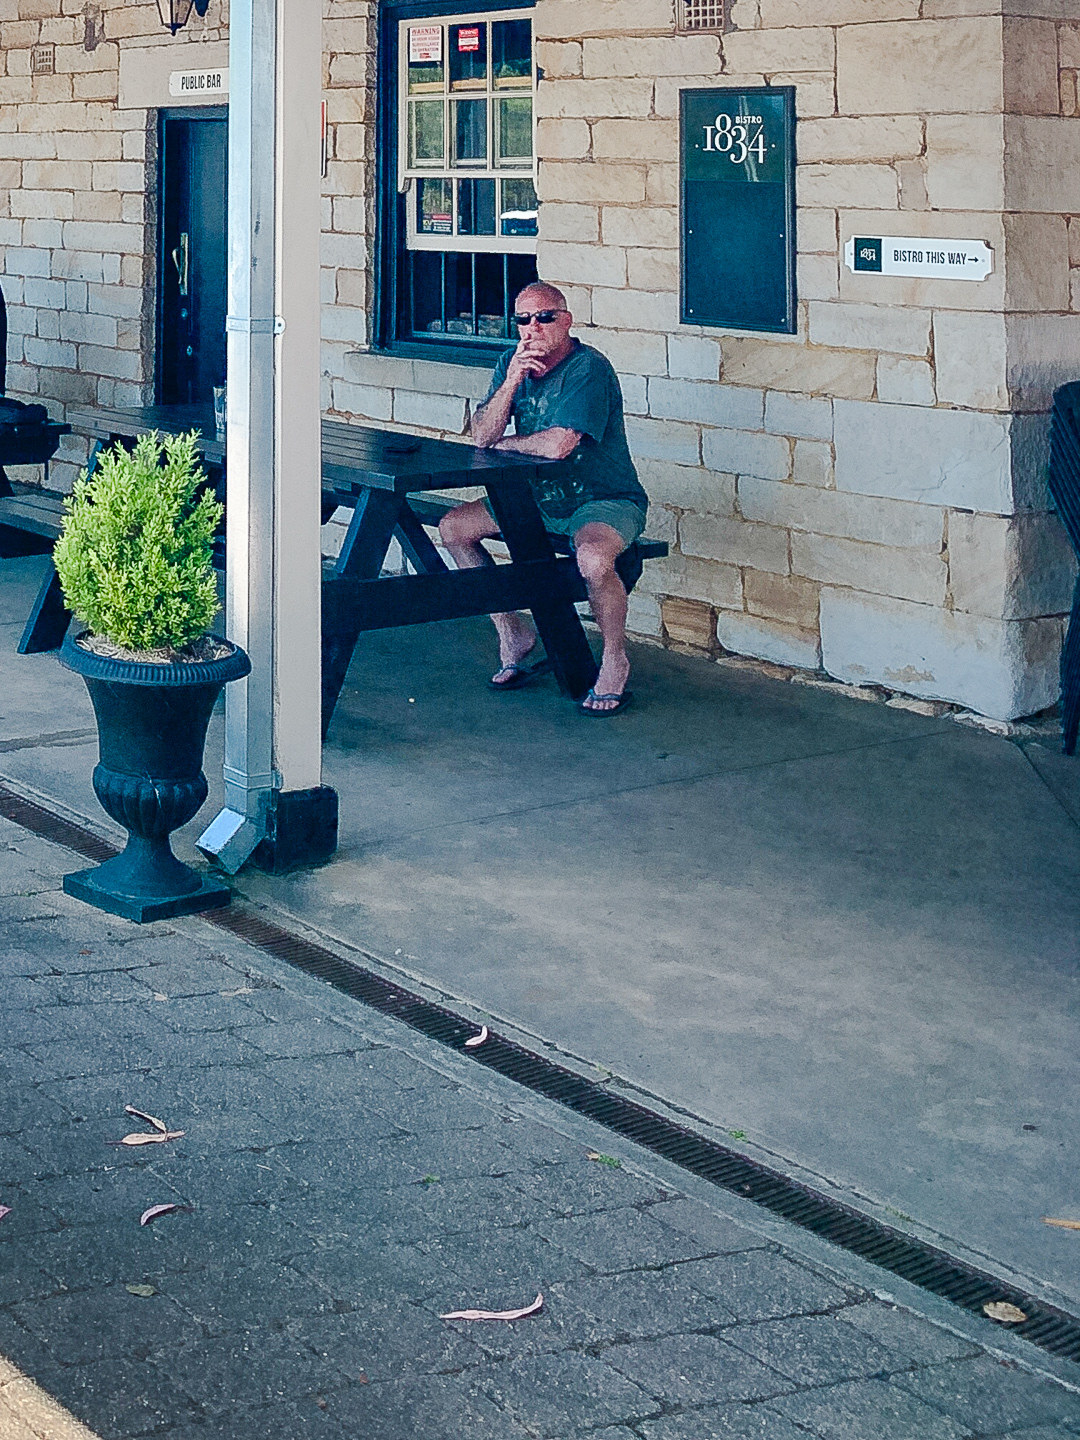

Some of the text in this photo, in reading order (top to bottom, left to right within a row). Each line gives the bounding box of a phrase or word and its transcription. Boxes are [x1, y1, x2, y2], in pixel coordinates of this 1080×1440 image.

[181, 73, 222, 90] PUBLIC BAR
[735, 115, 763, 124] BISTRO
[702, 113, 768, 164] 1834
[893, 249, 967, 265] BISTRO THIS WAY
